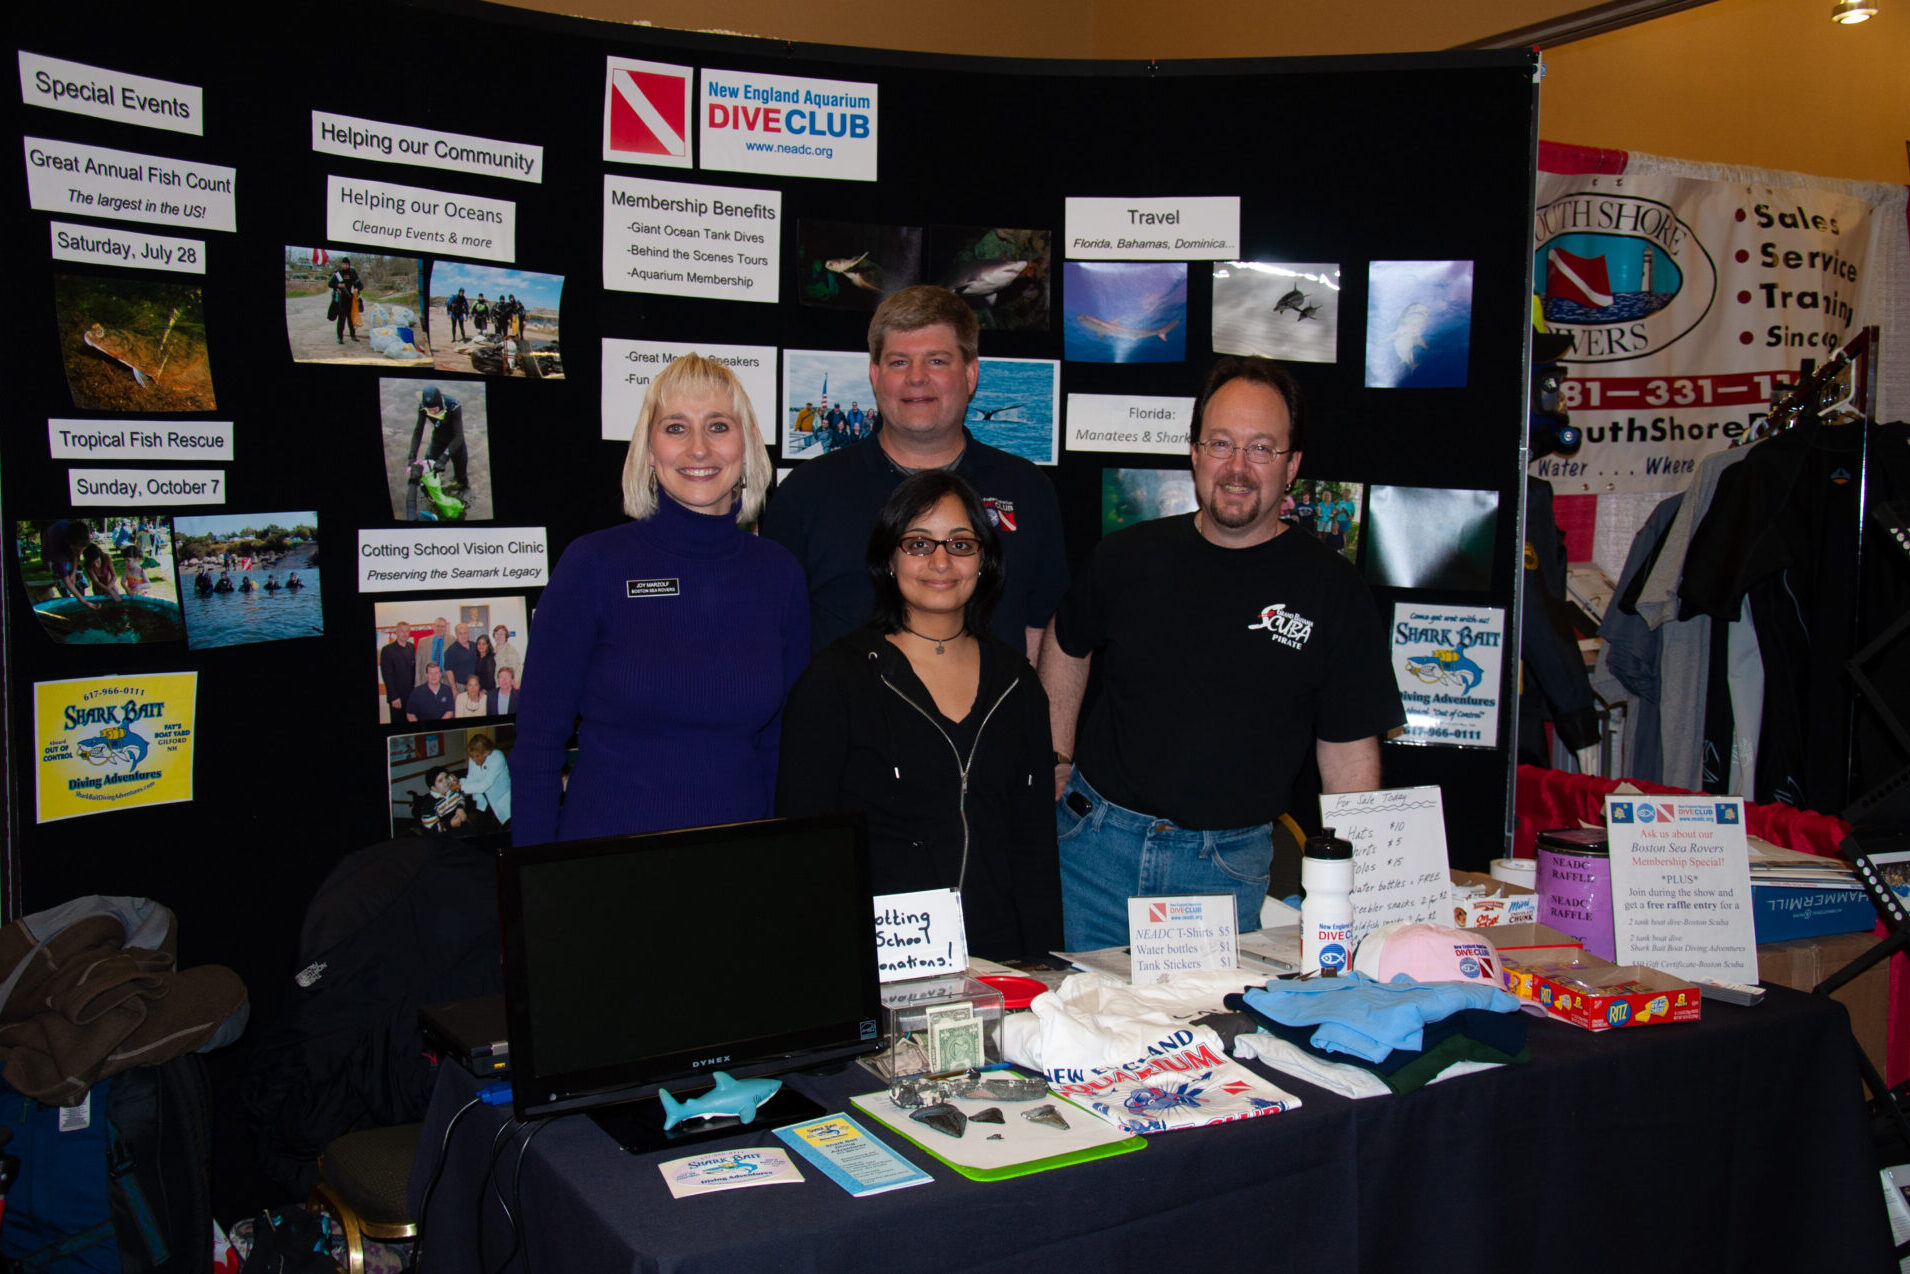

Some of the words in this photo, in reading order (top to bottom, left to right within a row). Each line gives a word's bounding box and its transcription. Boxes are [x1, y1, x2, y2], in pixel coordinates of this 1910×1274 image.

[35, 71, 115, 105] Special
[121, 88, 190, 119] Events
[708, 81, 739, 98] New
[744, 85, 799, 104] England
[804, 90, 871, 109] Aquarium
[321, 122, 392, 155] Helping
[399, 138, 429, 156] our
[434, 140, 534, 175] Community
[746, 141, 833, 159] www.neadc.org
[30, 149, 80, 172] Great
[85, 158, 142, 181] Annual
[148, 167, 181, 187] Fish
[186, 172, 231, 193] Count
[67, 189, 94, 204] The
[97, 193, 142, 211] largest
[145, 202, 157, 212] in
[161, 201, 180, 215] the
[183, 205, 206, 218] US!
[341, 187, 405, 214] Helping
[411, 200, 439, 215] our
[445, 202, 503, 224] Oceans
[611, 190, 708, 216] Membership
[713, 201, 776, 220] Benefits
[1127, 209, 1180, 225] Travel
[1754, 204, 1840, 235] Sales
[352, 220, 402, 239] Cleanup
[406, 227, 445, 243] Events
[448, 232, 458, 244] &
[461, 236, 492, 248] more
[627, 222, 661, 236] -Giant
[664, 225, 700, 238] Ocean
[704, 228, 731, 240] Tank
[733, 232, 765, 244] Dives
[1535, 200, 1591, 242] OUTH
[1598, 201, 1687, 256] SHORE
[57, 231, 136, 259] Saturday,
[141, 243, 172, 265] July
[177, 247, 196, 263] 28
[1073, 238, 1113, 250] Florida,
[1117, 238, 1171, 250] Bahamas,
[627, 245, 670, 259] -Behind
[672, 248, 690, 260] the
[693, 251, 734, 264] Scenes
[737, 253, 769, 266] Tours
[1760, 242, 1857, 282] Service
[626, 268, 684, 282] -Aquarium
[687, 272, 754, 288] Membership
[625, 351, 659, 363] -Great
[625, 374, 650, 385] -Fun
[1129, 407, 1176, 420] Florida:
[59, 430, 125, 451] Tropical
[130, 431, 163, 447] Fish
[168, 432, 224, 447] Rescue
[1076, 429, 1138, 442] Manatees
[1142, 431, 1151, 442] &
[1156, 432, 1191, 444] Shark
[1538, 459, 1588, 477] Water
[1646, 457, 1695, 474] Where
[77, 478, 142, 499] Sunday,
[147, 479, 207, 495] October
[211, 480, 220, 494] 7
[361, 543, 410, 559] Cotting
[413, 543, 460, 556] School
[463, 542, 504, 555] Vision
[508, 541, 544, 554] Clinic
[367, 570, 427, 582] Preserving
[430, 568, 447, 579] the
[451, 567, 499, 579] Seamark
[502, 567, 542, 578] Legacy
[1272, 634, 1303, 650] PIRATE
[84, 686, 145, 701] 617-966-0111
[1400, 691, 1431, 705] iving
[1432, 693, 1496, 706] Adventures
[154, 731, 172, 739] BOAT
[173, 729, 190, 737] YARD
[45, 746, 58, 754] OUT
[43, 754, 73, 762] CONTROL
[69, 778, 102, 790] Diving
[103, 771, 162, 785] Adventures
[1357, 795, 1375, 805] Sale
[1383, 793, 1408, 803] Today
[1348, 826, 1373, 840] Hats
[1390, 822, 1405, 832] $10
[1640, 829, 1657, 838] Ask
[1672, 829, 1696, 838] about
[1699, 831, 1713, 839] our
[1631, 843, 1666, 853] Boston
[1669, 843, 1687, 853] Sea
[1690, 843, 1724, 853] Rovers
[1552, 857, 1591, 870] NEADC
[1632, 857, 1687, 868] Membership
[1689, 858, 1725, 868] Special!
[1377, 882, 1407, 892] bottles
[1417, 872, 1441, 885] FREE
[1552, 870, 1595, 883] RAFFLE
[1629, 887, 1646, 897] Join
[1648, 888, 1676, 898] during
[1678, 888, 1691, 897] the
[1693, 888, 1715, 897] show
[1718, 888, 1734, 897] and
[1550, 895, 1588, 908] NEADC
[1625, 902, 1637, 911] get
[1647, 901, 1664, 909] free
[1667, 901, 1690, 909] raffle
[1694, 902, 1717, 911] entry
[1720, 901, 1732, 909] for
[1551, 908, 1593, 921] RAFFLE
[1667, 918, 1706, 926] dive-Boston
[1136, 928, 1175, 939] NEADC
[1178, 928, 1214, 938] T-Shirts
[1219, 926, 1230, 937] $5
[1137, 945, 1164, 955] Water
[1167, 943, 1198, 954] bottles
[1220, 942, 1230, 952] $1
[1685, 945, 1707, 953] Diving
[1137, 961, 1160, 971] Tank
[1164, 959, 1201, 969] Stickers
[1221, 957, 1231, 967] $1
[1610, 1003, 1628, 1023] RITZ
[692, 1055, 731, 1068] DYNEX
